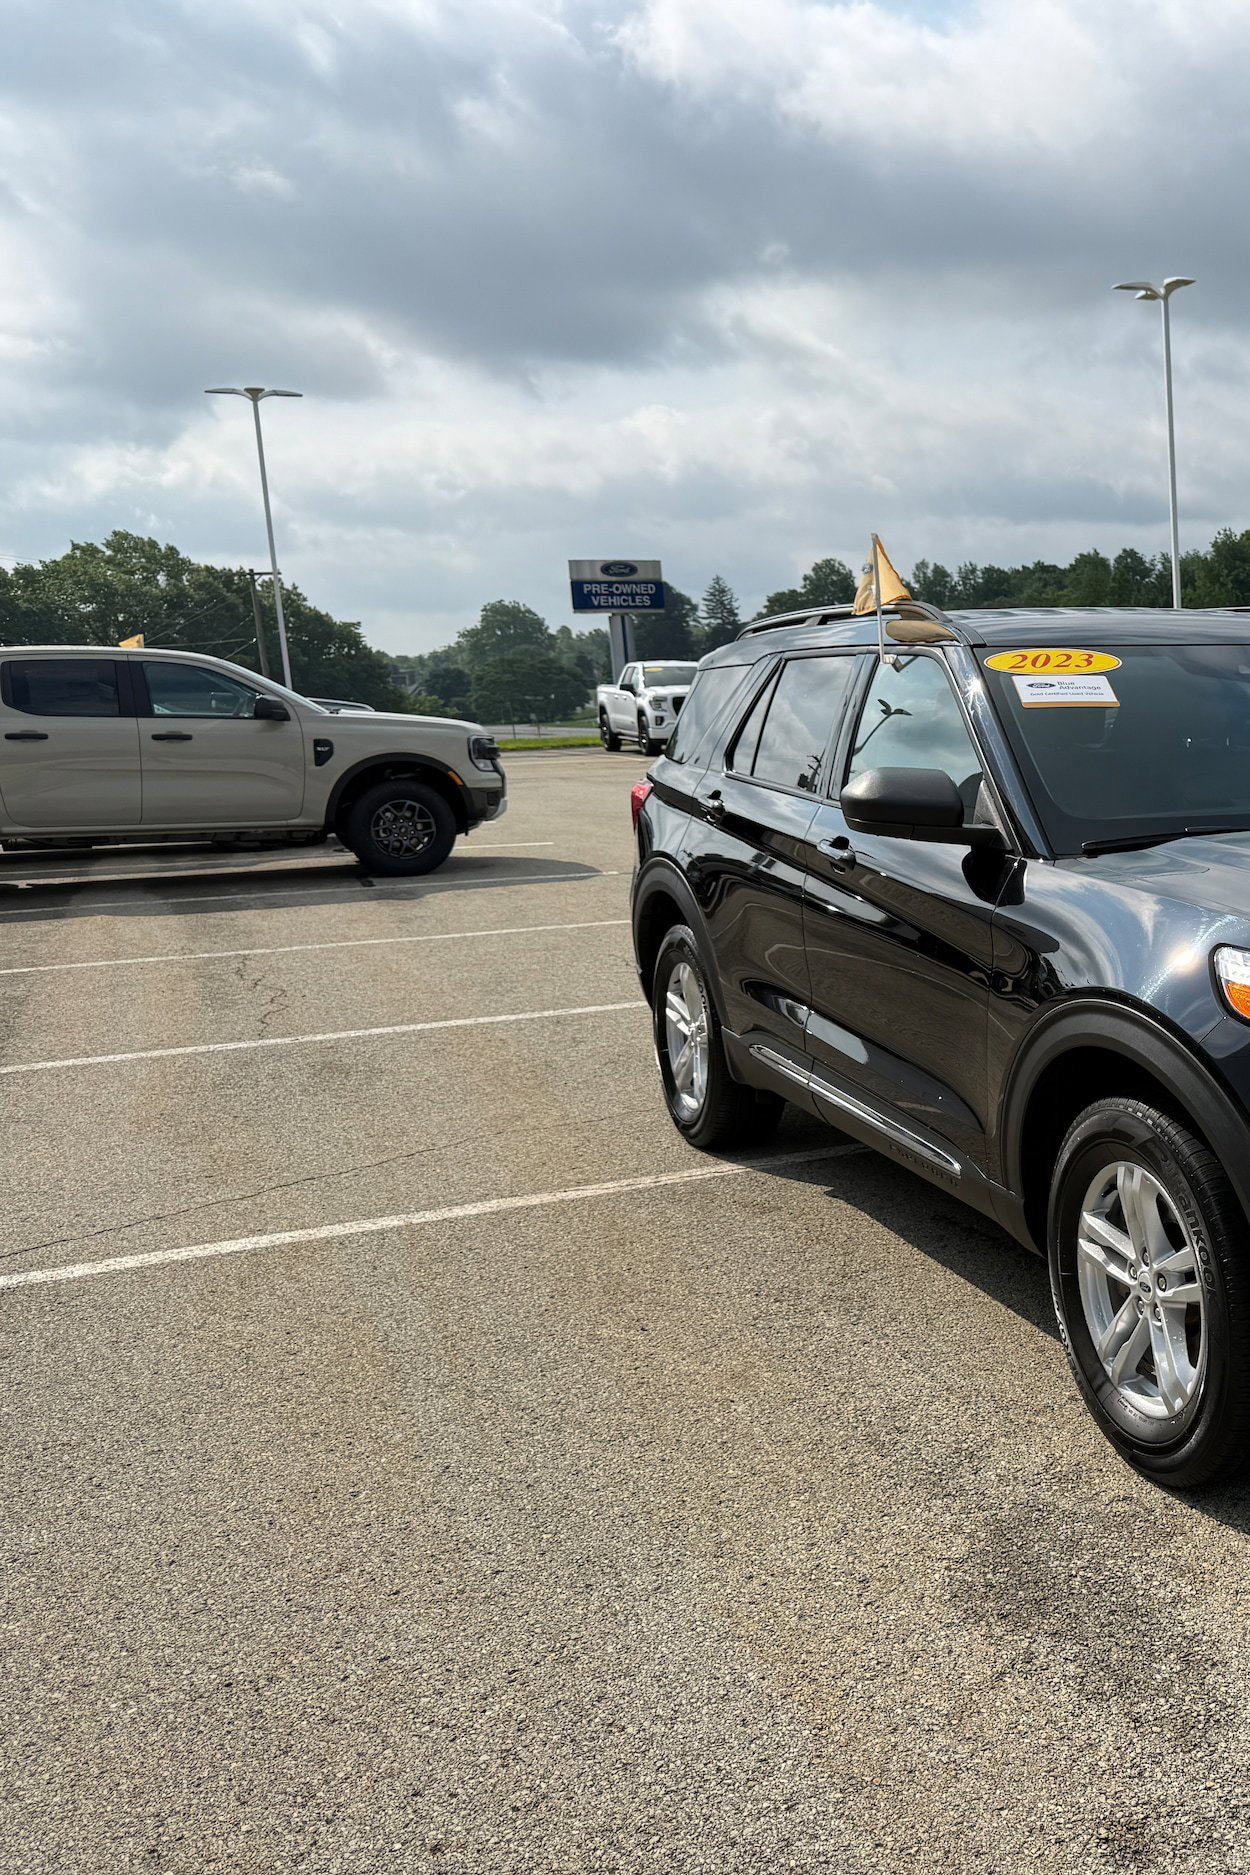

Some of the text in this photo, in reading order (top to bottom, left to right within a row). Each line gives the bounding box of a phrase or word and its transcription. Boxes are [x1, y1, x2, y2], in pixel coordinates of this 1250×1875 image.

[608, 565, 631, 574] Ford
[583, 583, 656, 594] PRE-OWNED
[591, 595, 651, 606] VEHICLES
[1008, 653, 1094, 670] 2023
